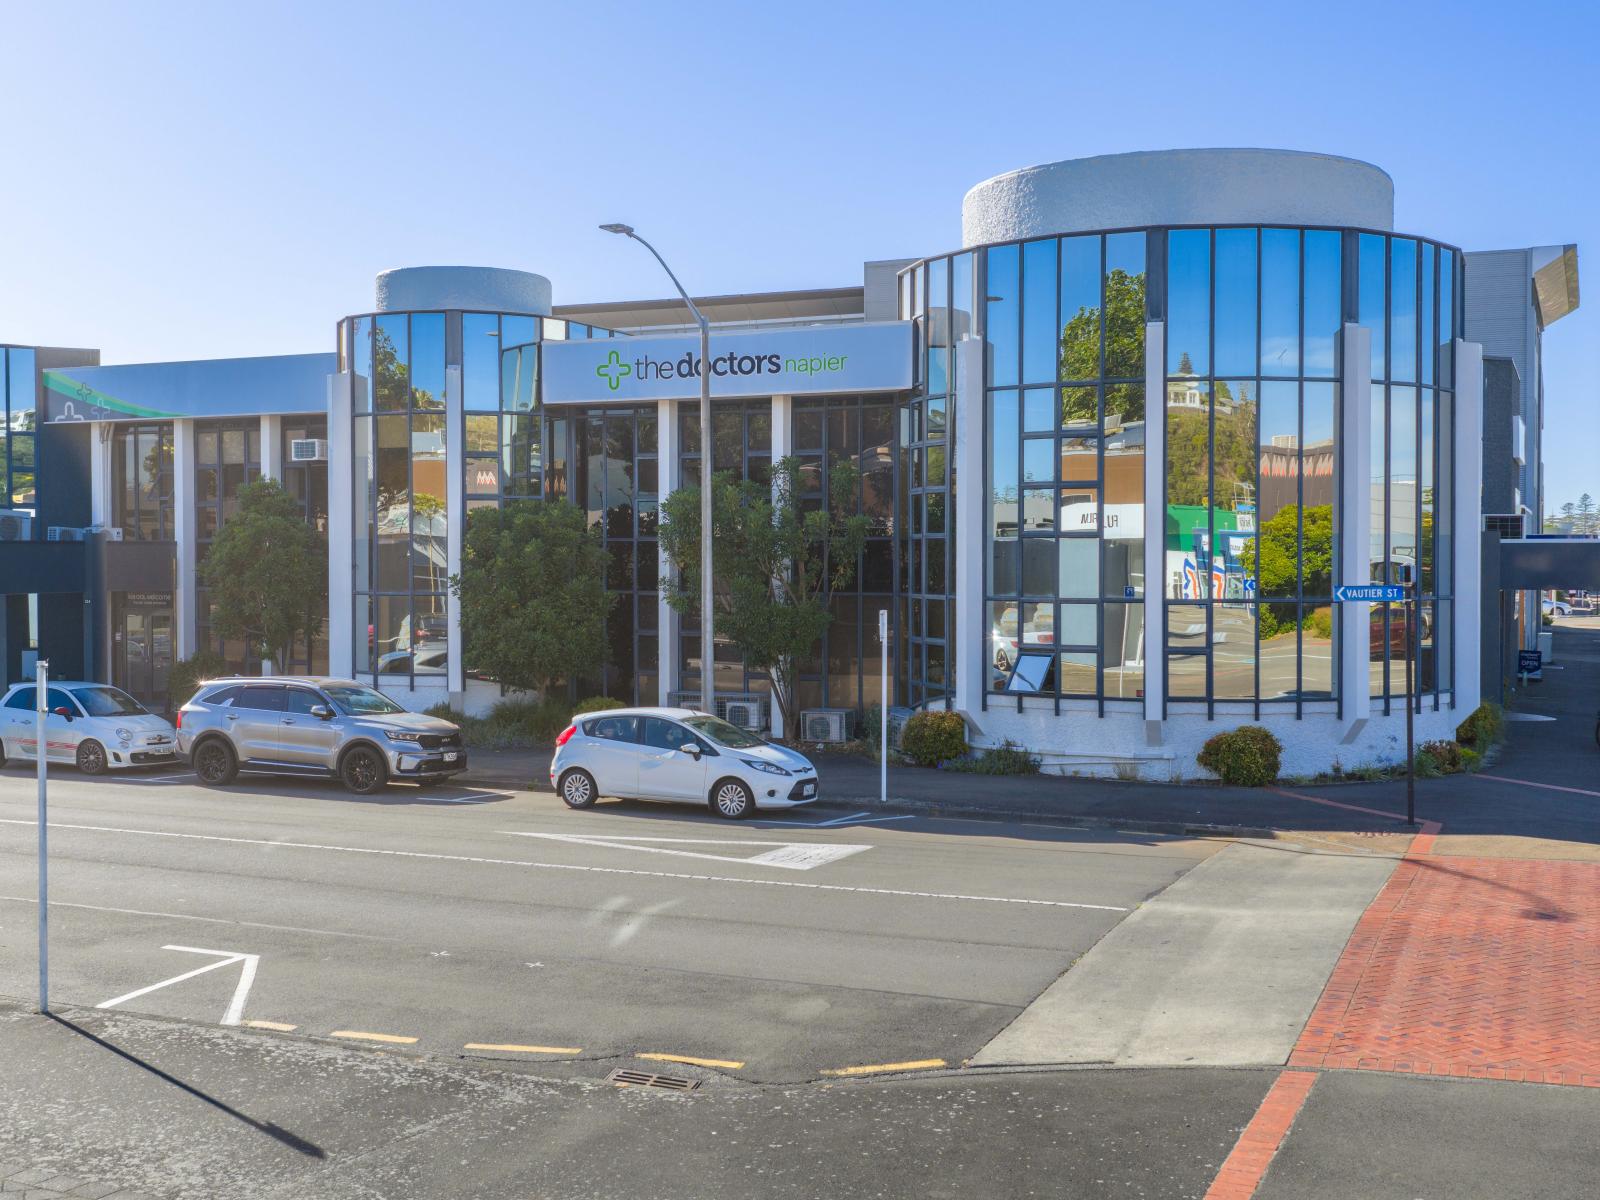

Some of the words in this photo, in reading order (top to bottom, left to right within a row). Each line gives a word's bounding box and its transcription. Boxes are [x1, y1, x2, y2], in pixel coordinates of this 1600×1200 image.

[635, 355, 674, 380] the
[677, 352, 781, 378] doctors
[785, 352, 848, 376] napier
[1346, 588, 1383, 599] VAUTIER
[1387, 588, 1398, 598] ST
